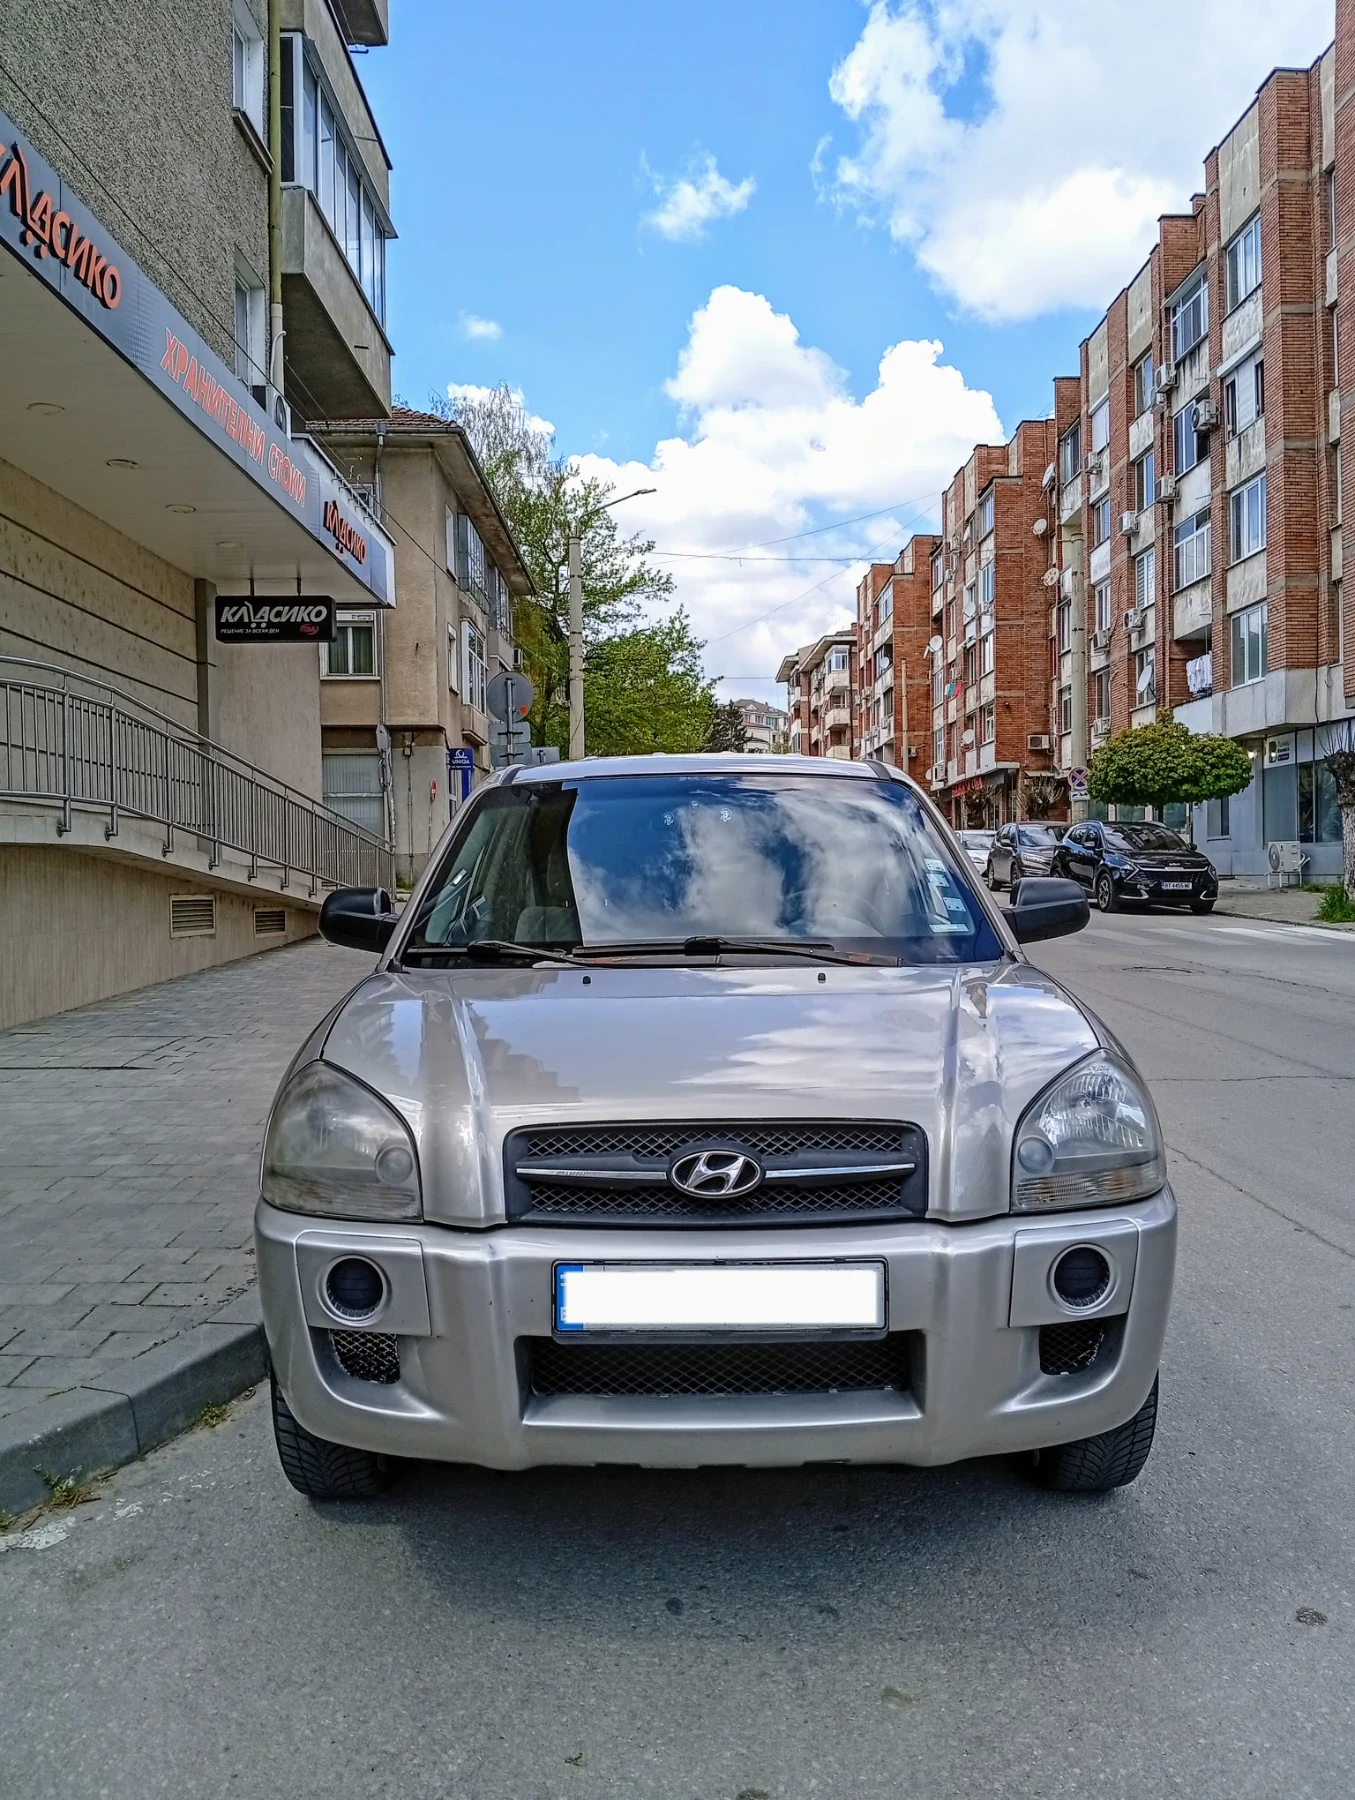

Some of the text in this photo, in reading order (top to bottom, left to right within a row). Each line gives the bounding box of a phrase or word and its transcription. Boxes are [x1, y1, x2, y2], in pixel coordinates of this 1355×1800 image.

[0, 141, 122, 309] ЛАСИКО
[160, 326, 307, 508] ХРАНИТЕЛНИ СТОКИ
[324, 500, 367, 564] КЛАСИКО
[220, 601, 328, 627] КЛАСИКО
